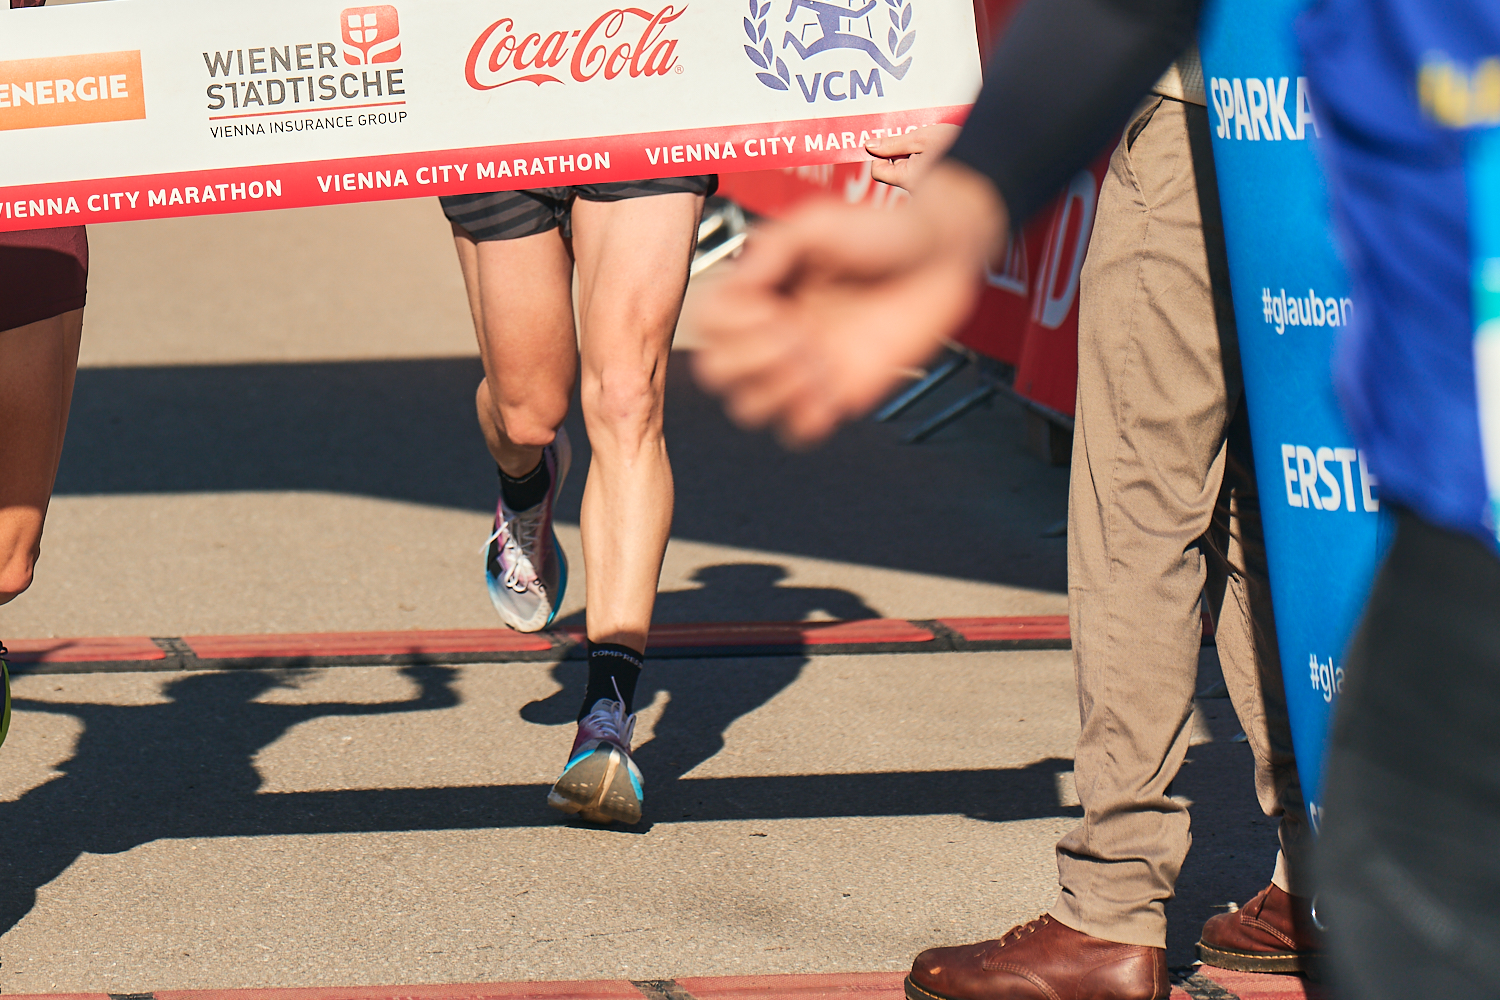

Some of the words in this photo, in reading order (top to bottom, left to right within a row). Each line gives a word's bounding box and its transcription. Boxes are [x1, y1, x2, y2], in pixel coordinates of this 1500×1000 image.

[202, 42, 339, 78] WIENER
[464, 3, 689, 91] Coca-Cola
[206, 68, 406, 110] STÄDTISCHE
[795, 67, 885, 103] VCM
[209, 122, 266, 139] VIENNA
[269, 115, 354, 134] INSURANCE
[358, 111, 408, 126] GROUP
[645, 141, 737, 166] VIENNA
[745, 135, 797, 157] CITY
[317, 168, 410, 194] VIENNA
[415, 162, 469, 186] CITY
[476, 151, 611, 180] MARATHON
[87, 191, 140, 213] CITY
[147, 179, 283, 207] MARATHON
